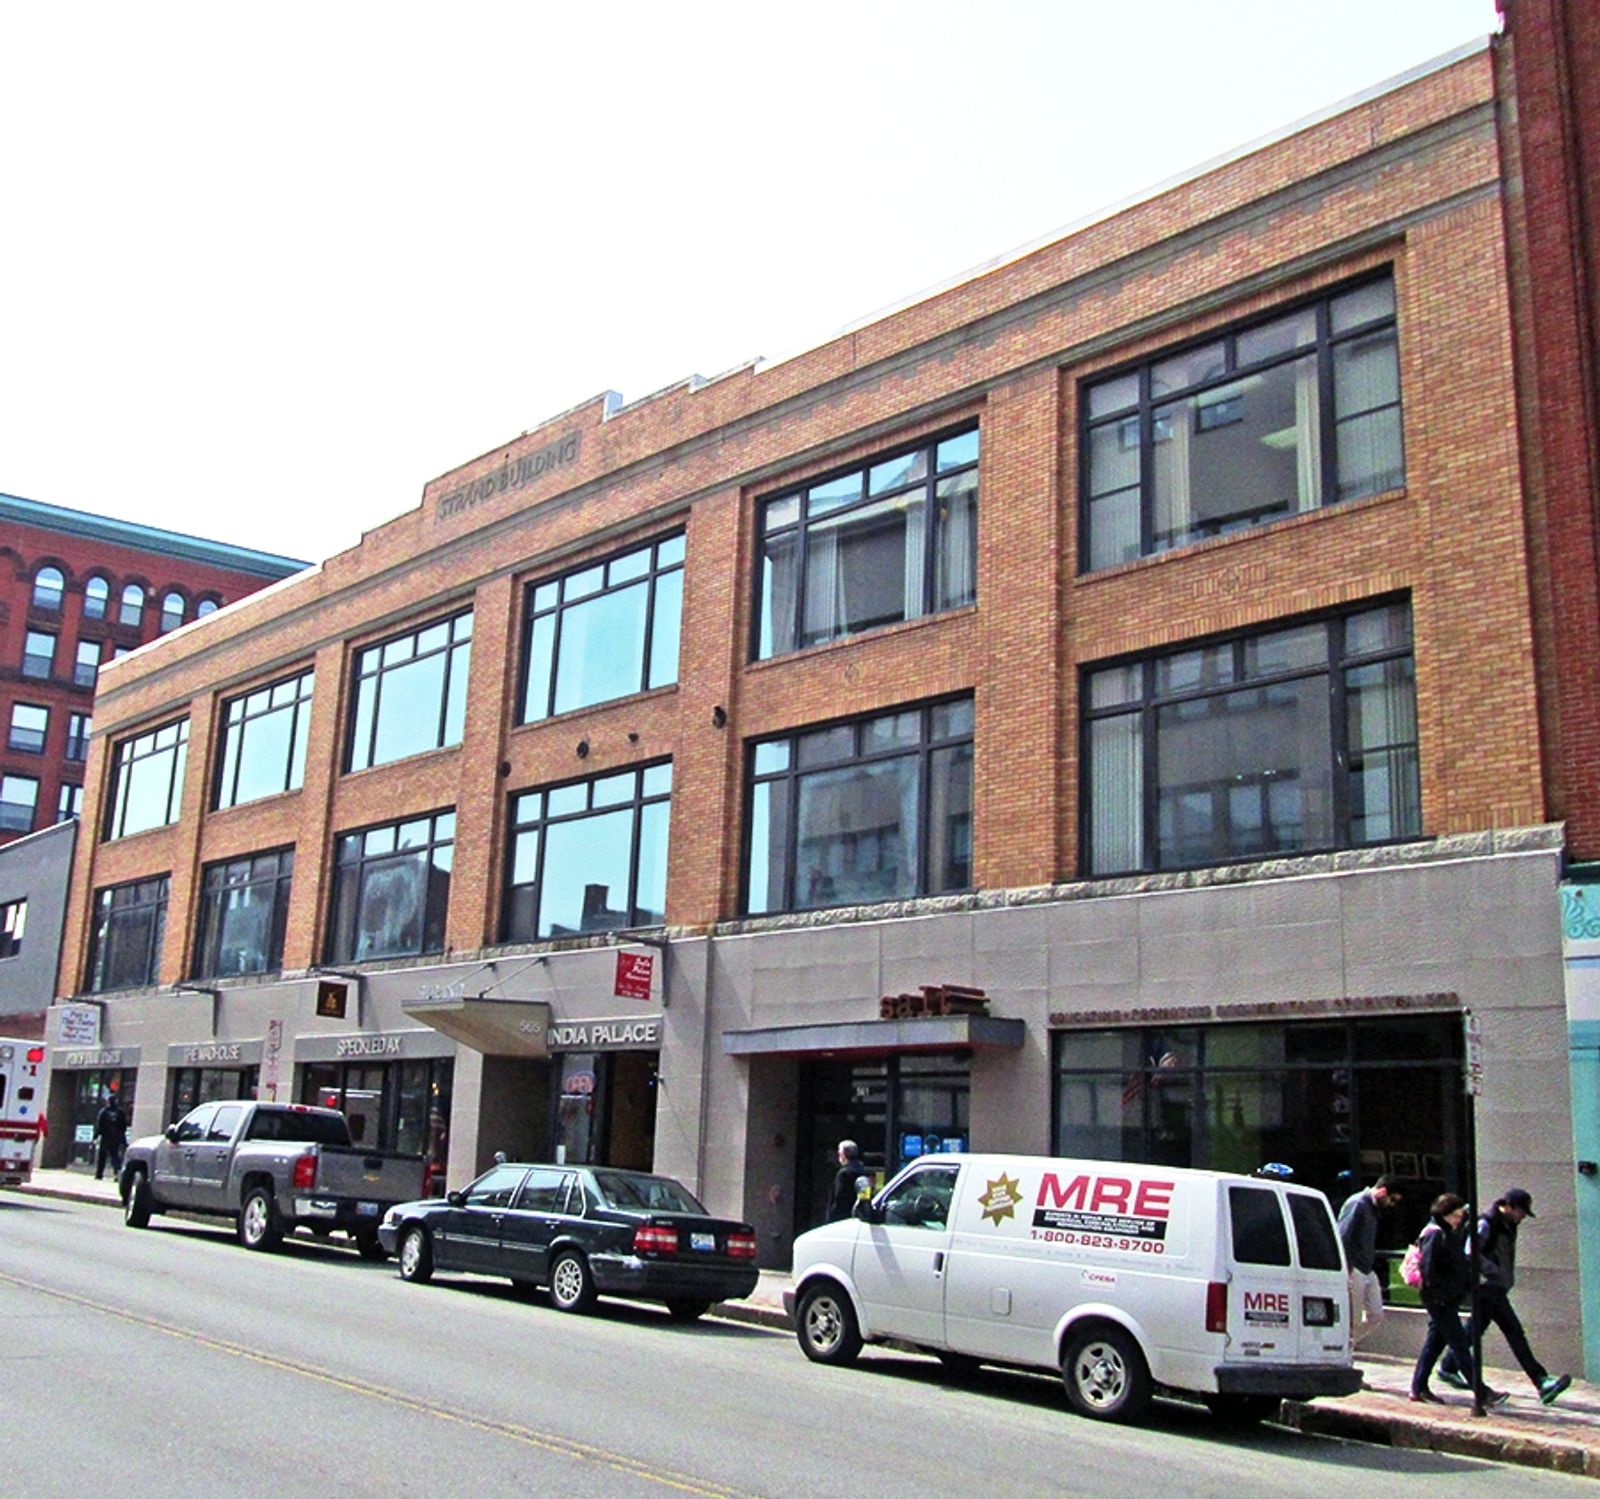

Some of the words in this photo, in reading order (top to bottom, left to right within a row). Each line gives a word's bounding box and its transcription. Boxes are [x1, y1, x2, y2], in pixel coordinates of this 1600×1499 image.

[440, 477, 495, 520] STRAND
[498, 438, 578, 492] BUILDING
[591, 1023, 657, 1043] PALACE
[29, 1064, 37, 1077] 1
[1036, 1172, 1175, 1219] MRE
[1243, 1291, 1290, 1313] MRE
